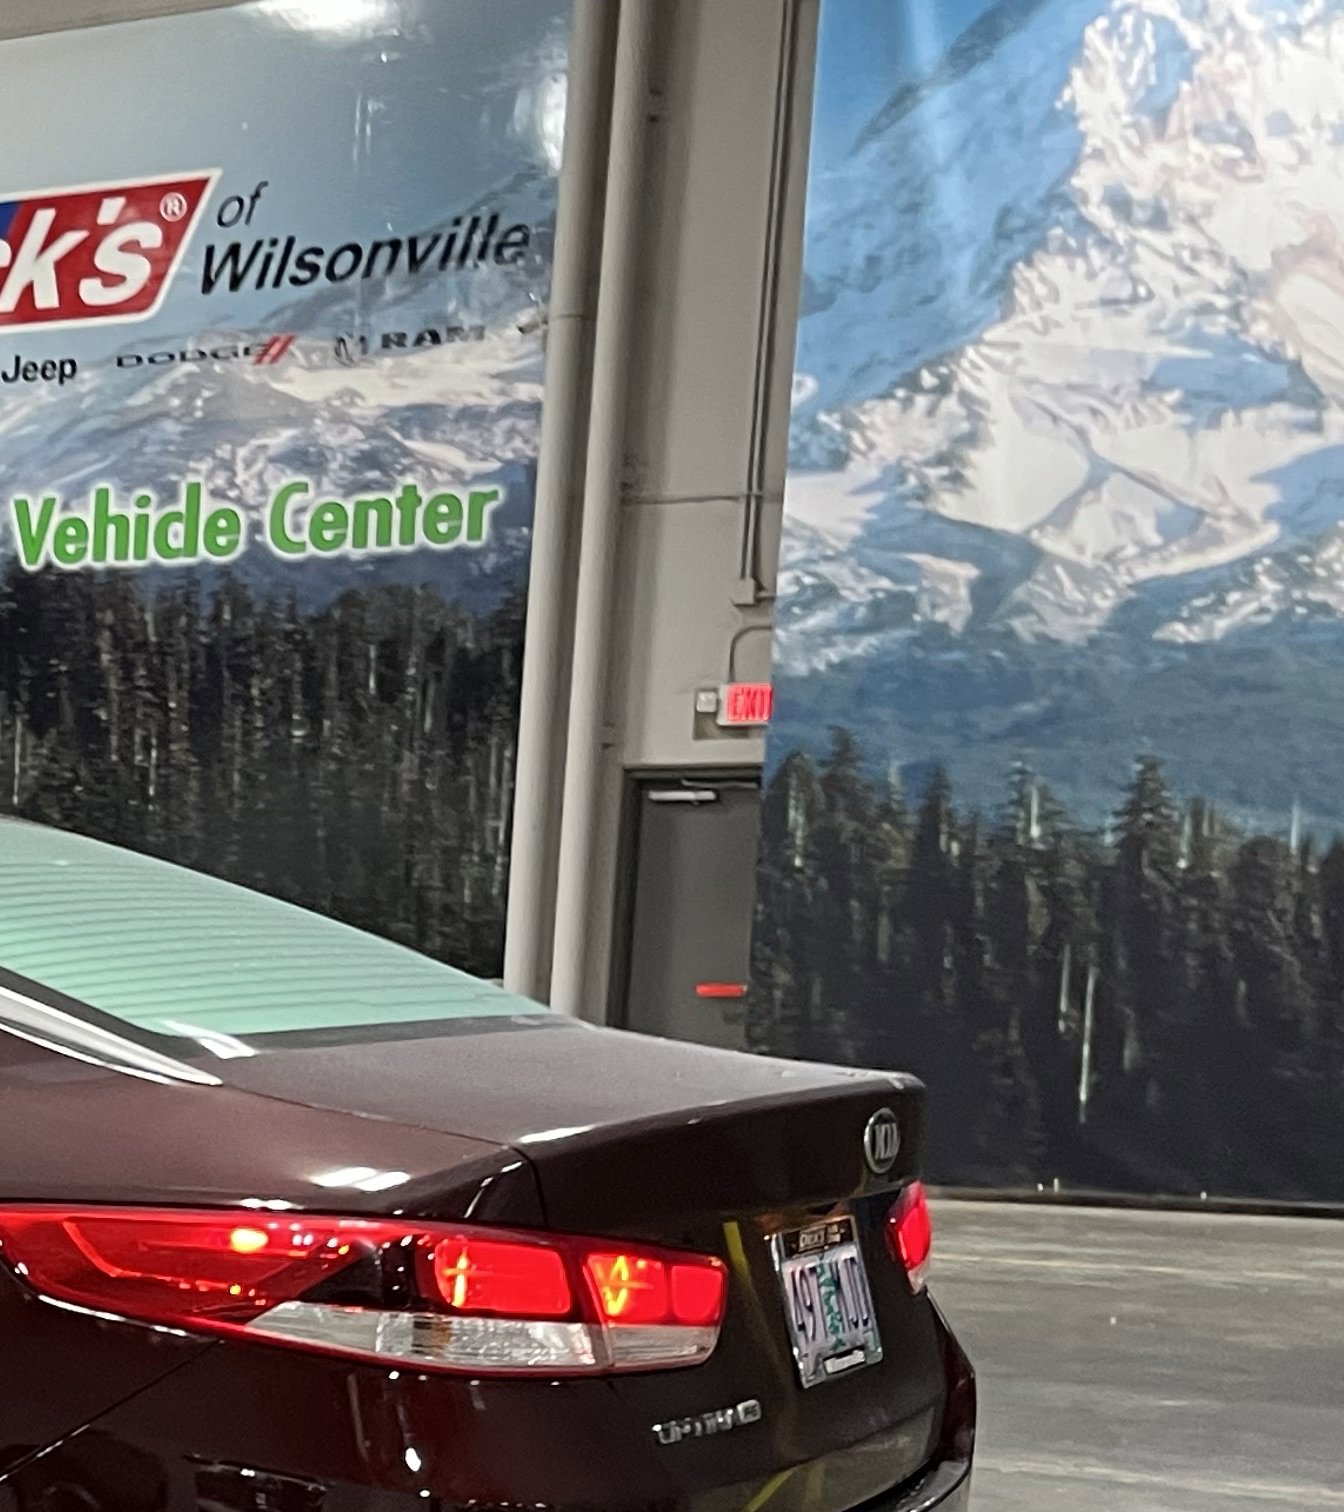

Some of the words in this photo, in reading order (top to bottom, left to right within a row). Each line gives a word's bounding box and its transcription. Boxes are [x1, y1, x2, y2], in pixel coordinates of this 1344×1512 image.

[217, 181, 268, 227] of
[201, 213, 530, 295] Wilsonville
[1, 354, 78, 386] Jeep
[381, 325, 487, 350] RAM
[13, 482, 243, 568] Vehicle
[269, 481, 500, 555] Center
[729, 684, 771, 721] EXIT
